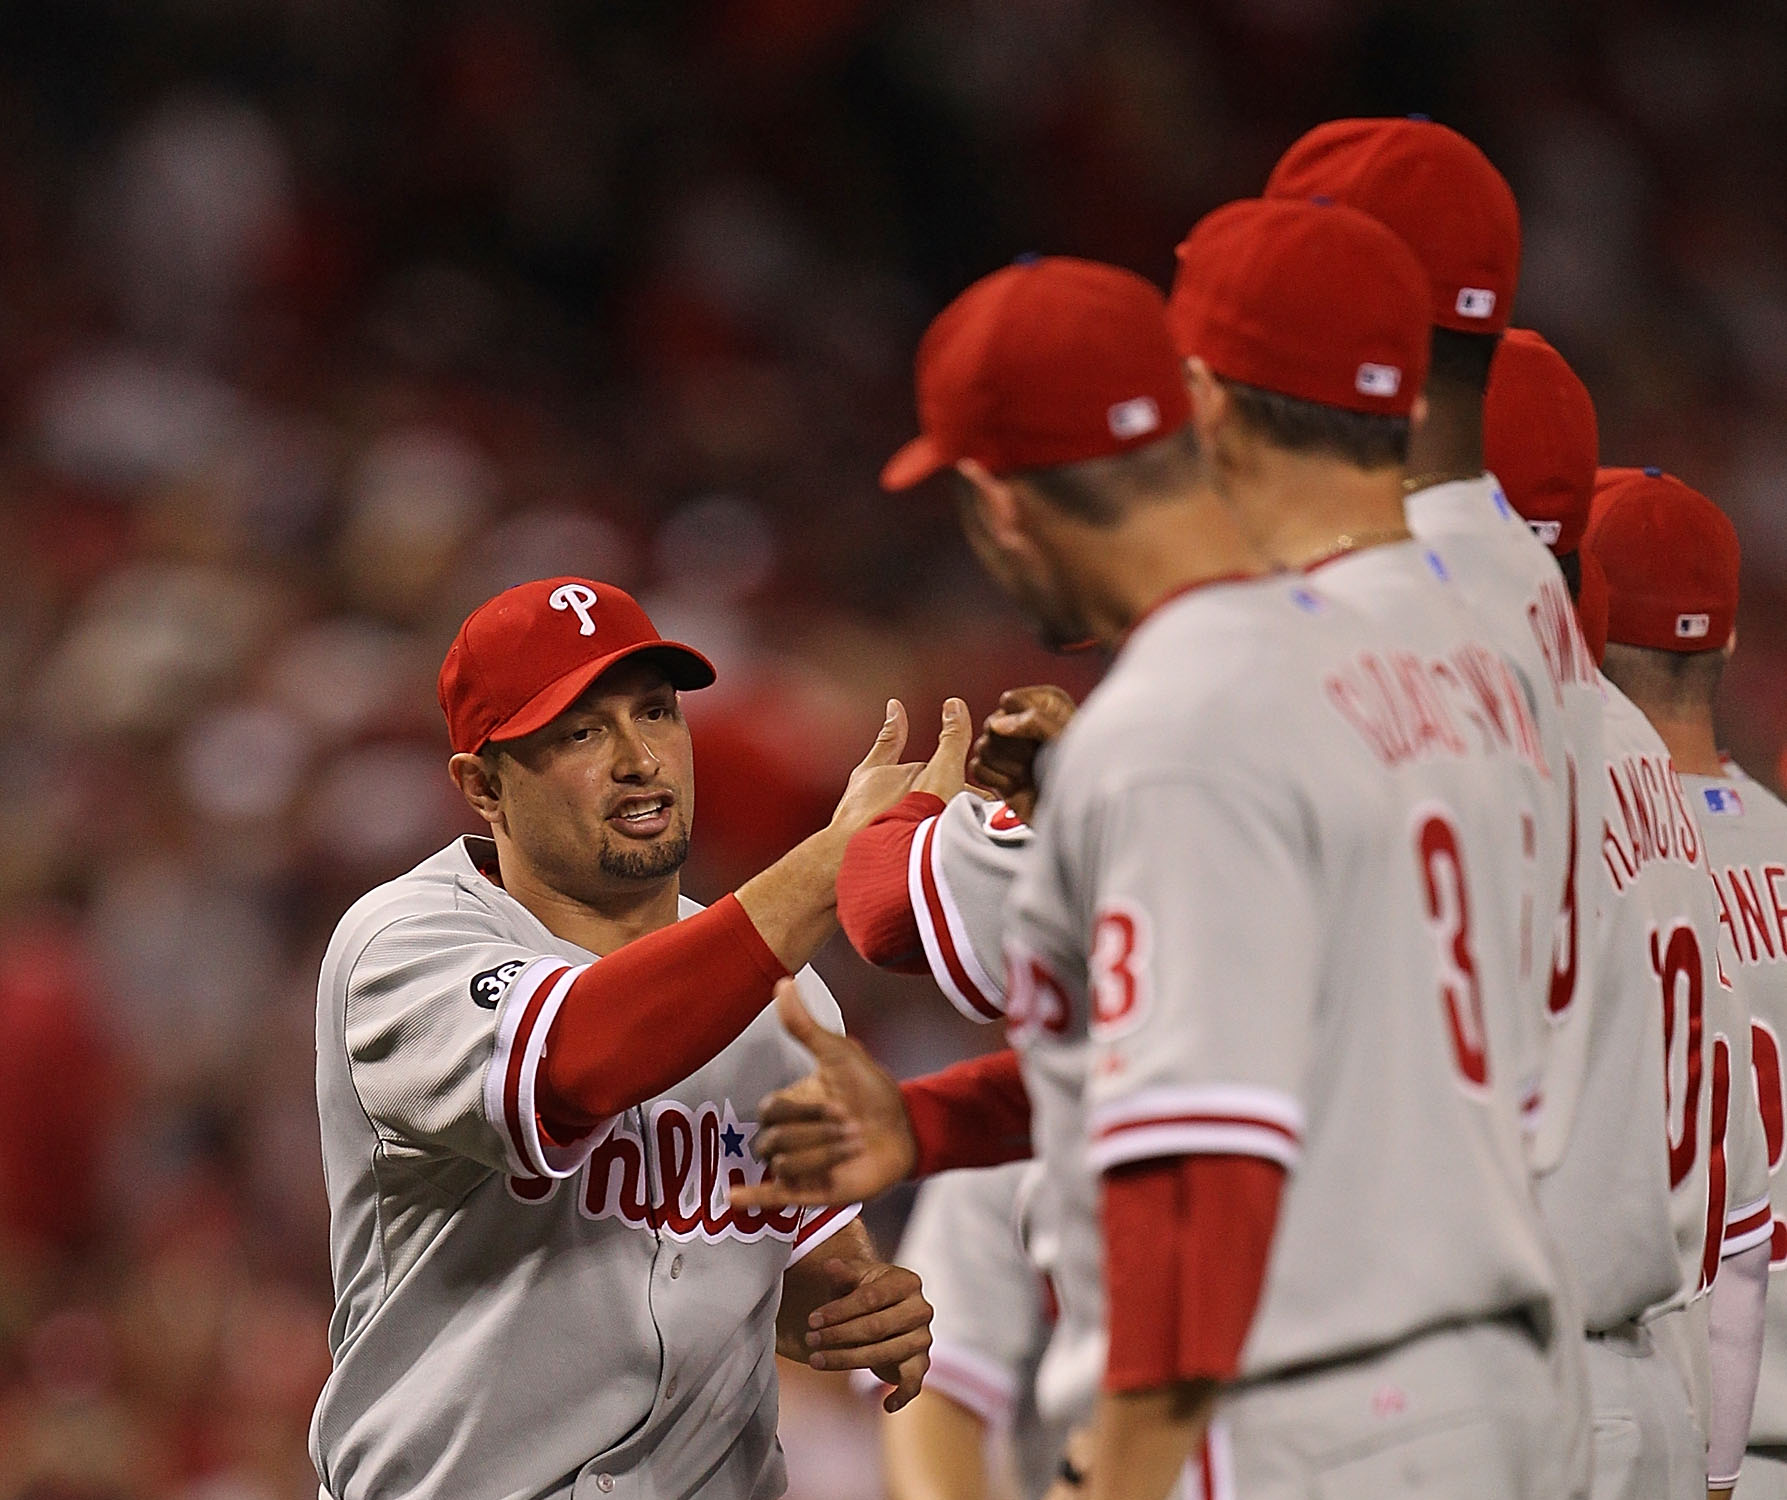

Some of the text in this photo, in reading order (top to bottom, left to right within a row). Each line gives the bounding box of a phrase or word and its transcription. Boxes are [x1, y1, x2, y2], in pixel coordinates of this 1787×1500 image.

[549, 584, 597, 636] P
[1414, 811, 1488, 1090] 3
[476, 963, 521, 1002] 36
